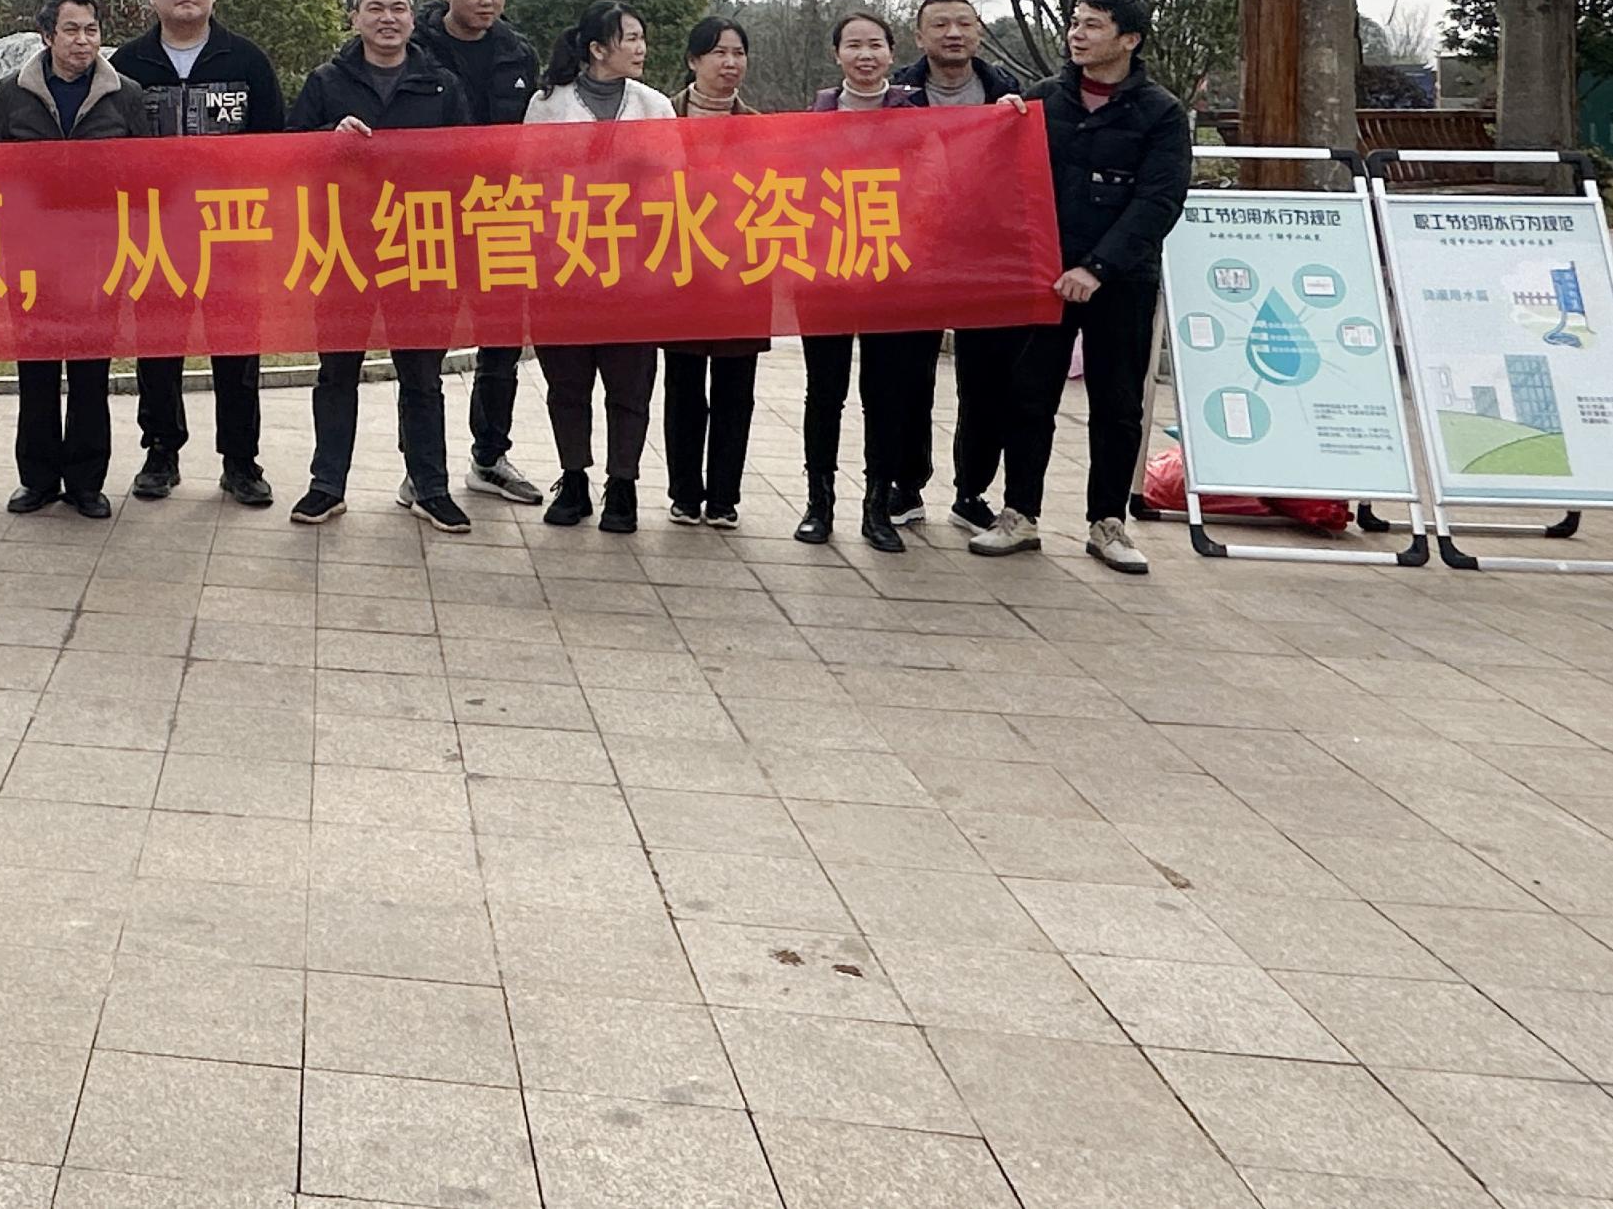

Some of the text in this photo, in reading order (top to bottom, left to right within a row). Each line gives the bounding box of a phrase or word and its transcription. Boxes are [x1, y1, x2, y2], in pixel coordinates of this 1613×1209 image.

[1184, 207, 1341, 226] 职工节约用水行为规范
[1413, 214, 1575, 232] 职工节约用水行为规范
